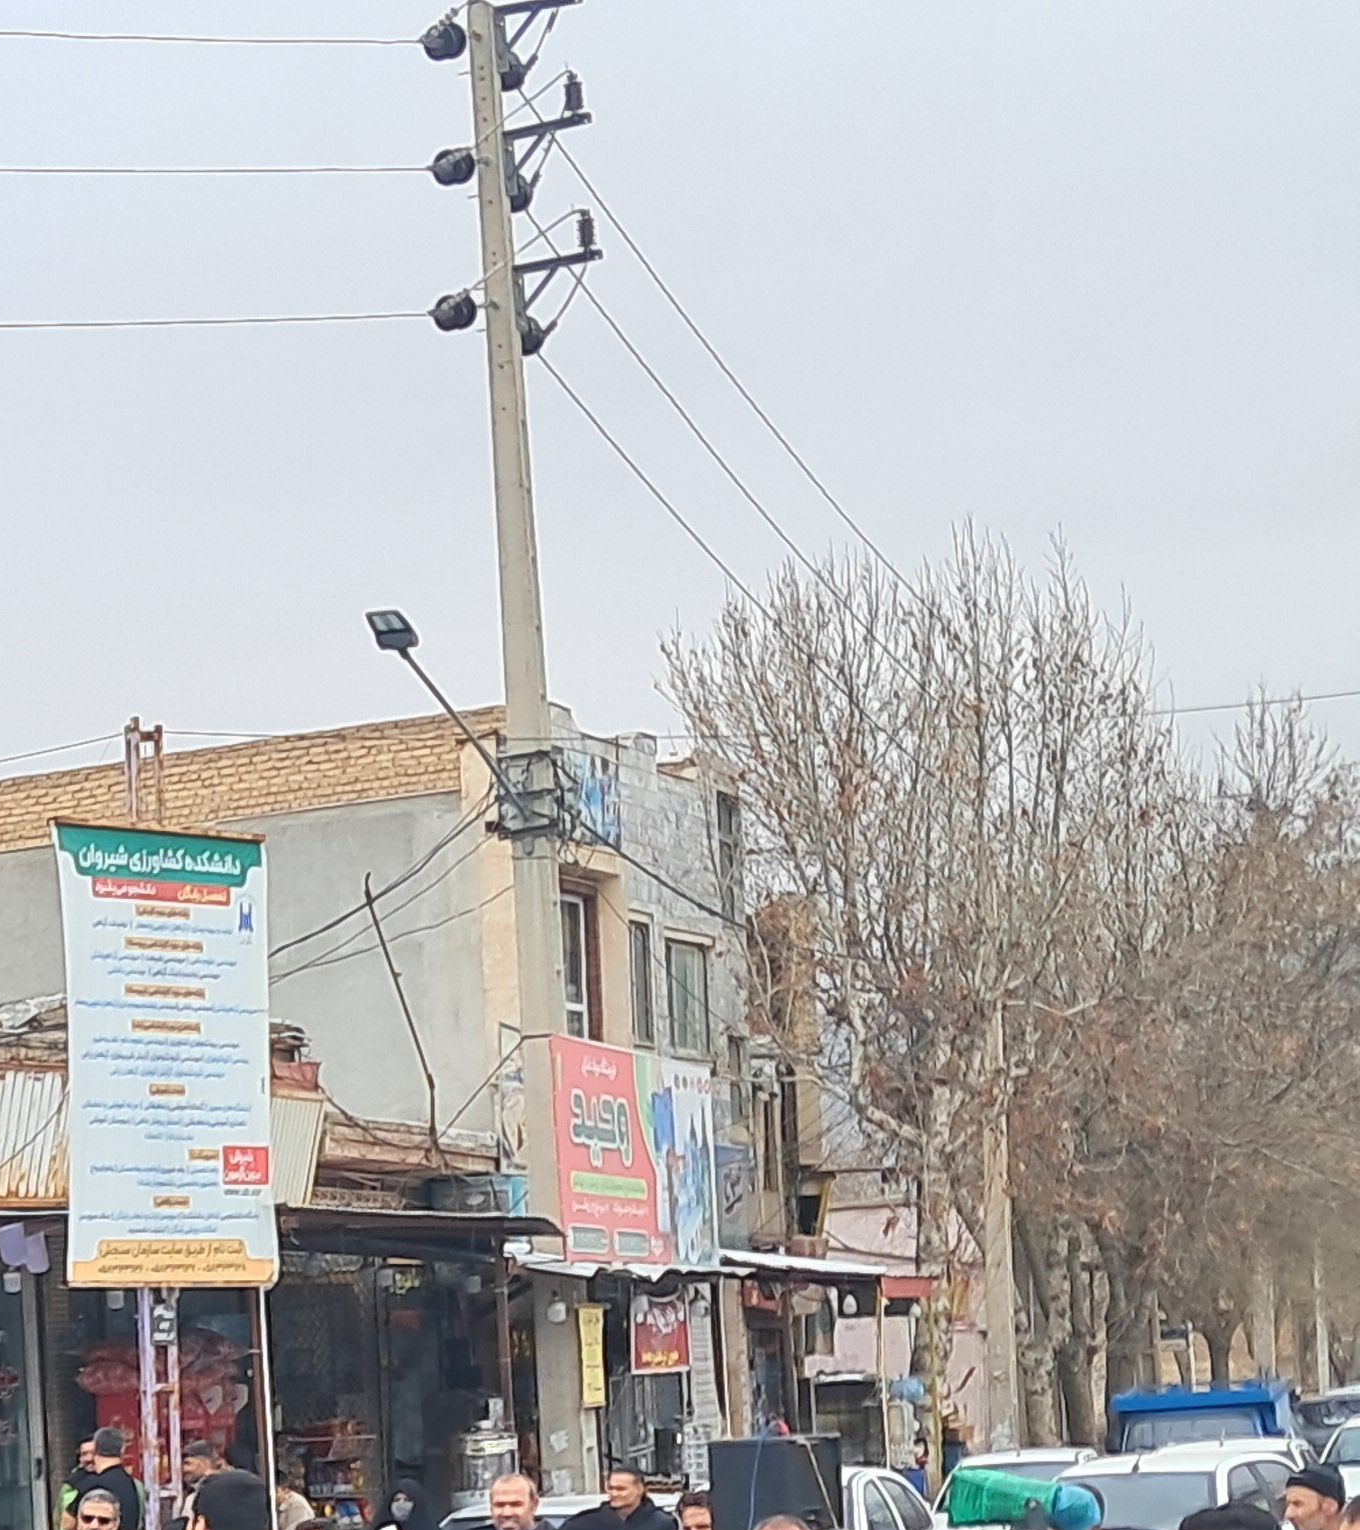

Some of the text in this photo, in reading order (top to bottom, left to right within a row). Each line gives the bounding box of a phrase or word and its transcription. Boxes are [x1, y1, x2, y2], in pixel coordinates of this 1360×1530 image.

[77, 841, 242, 876] دانشکده کشاورزی شیروان
